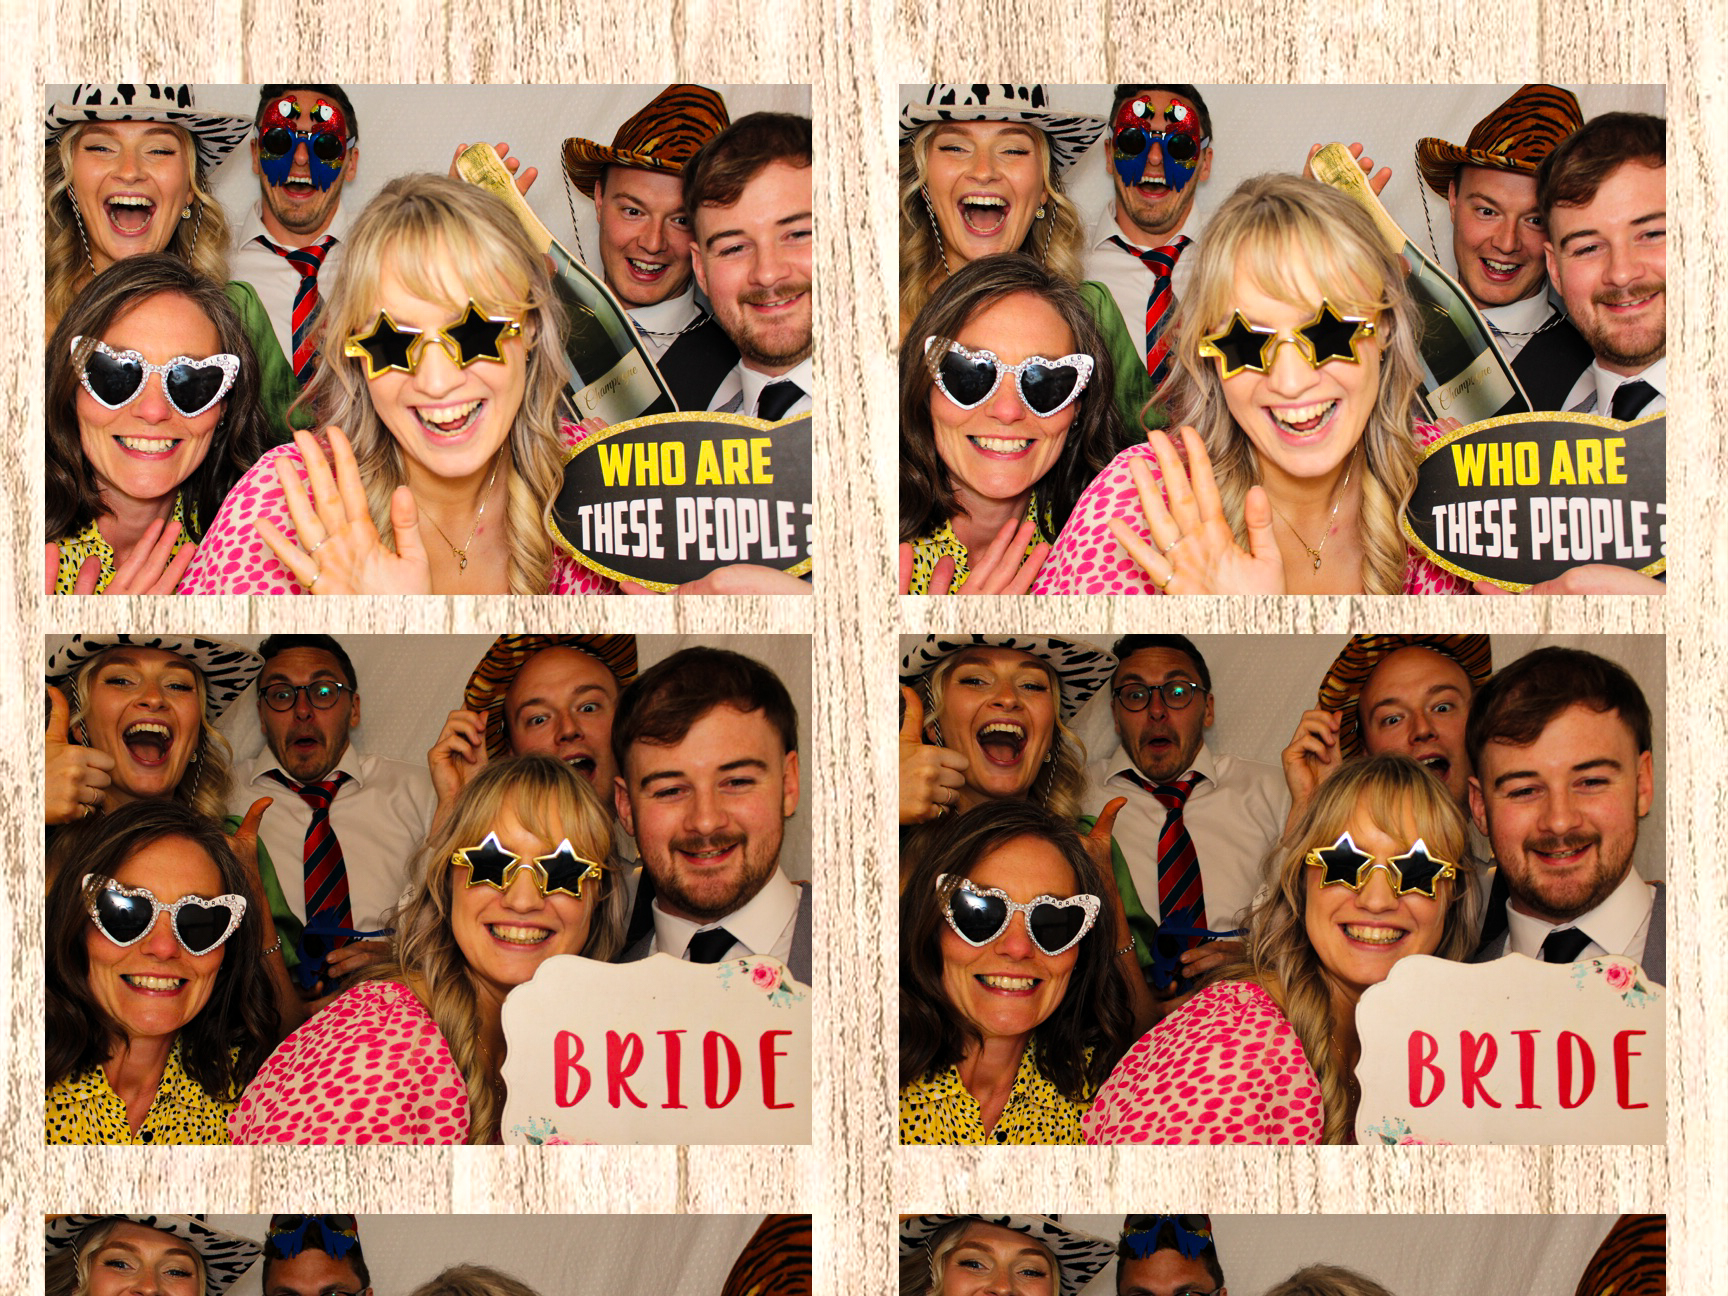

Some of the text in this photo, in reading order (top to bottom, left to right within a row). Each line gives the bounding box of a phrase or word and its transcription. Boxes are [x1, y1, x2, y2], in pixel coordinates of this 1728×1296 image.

[180, 355, 228, 367] MARRIED
[1034, 355, 1082, 367] MARRIED
[597, 437, 775, 487] WHO ARE
[1451, 437, 1629, 487] WHO ARE
[577, 497, 665, 560] THESE
[1431, 497, 1519, 560] THESE
[190, 894, 236, 906] MARRIED
[1044, 894, 1090, 906] MARRIED
[553, 1029, 795, 1110] BRIDE
[1407, 1029, 1649, 1110] BRIDE
